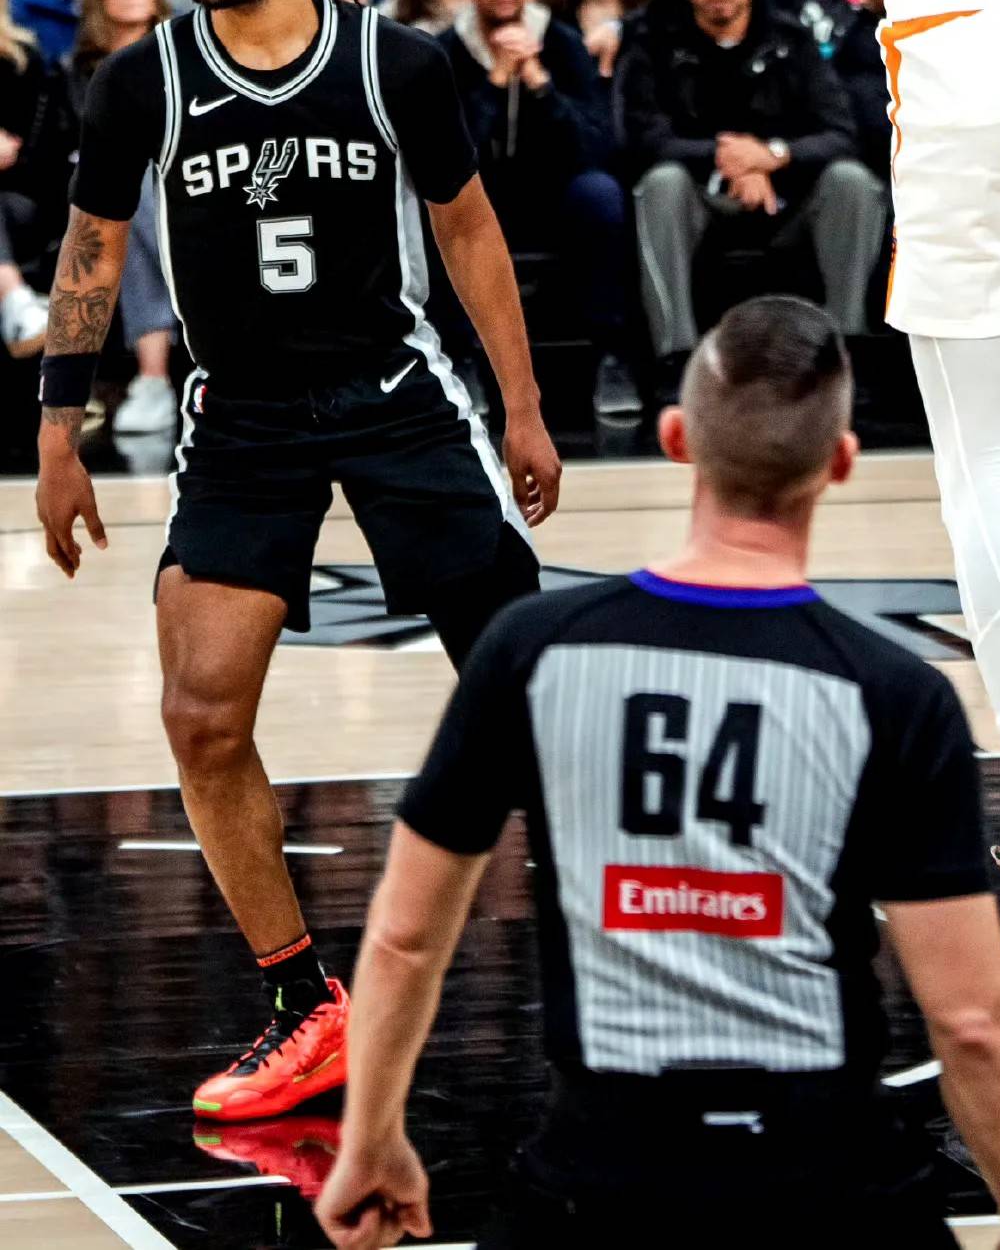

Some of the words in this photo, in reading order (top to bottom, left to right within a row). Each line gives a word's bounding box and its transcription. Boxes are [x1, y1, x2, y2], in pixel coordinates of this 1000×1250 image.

[182, 137, 377, 211] SPURS
[256, 215, 317, 294] 5
[618, 692, 768, 847] 64
[618, 878, 768, 922] Emirates
